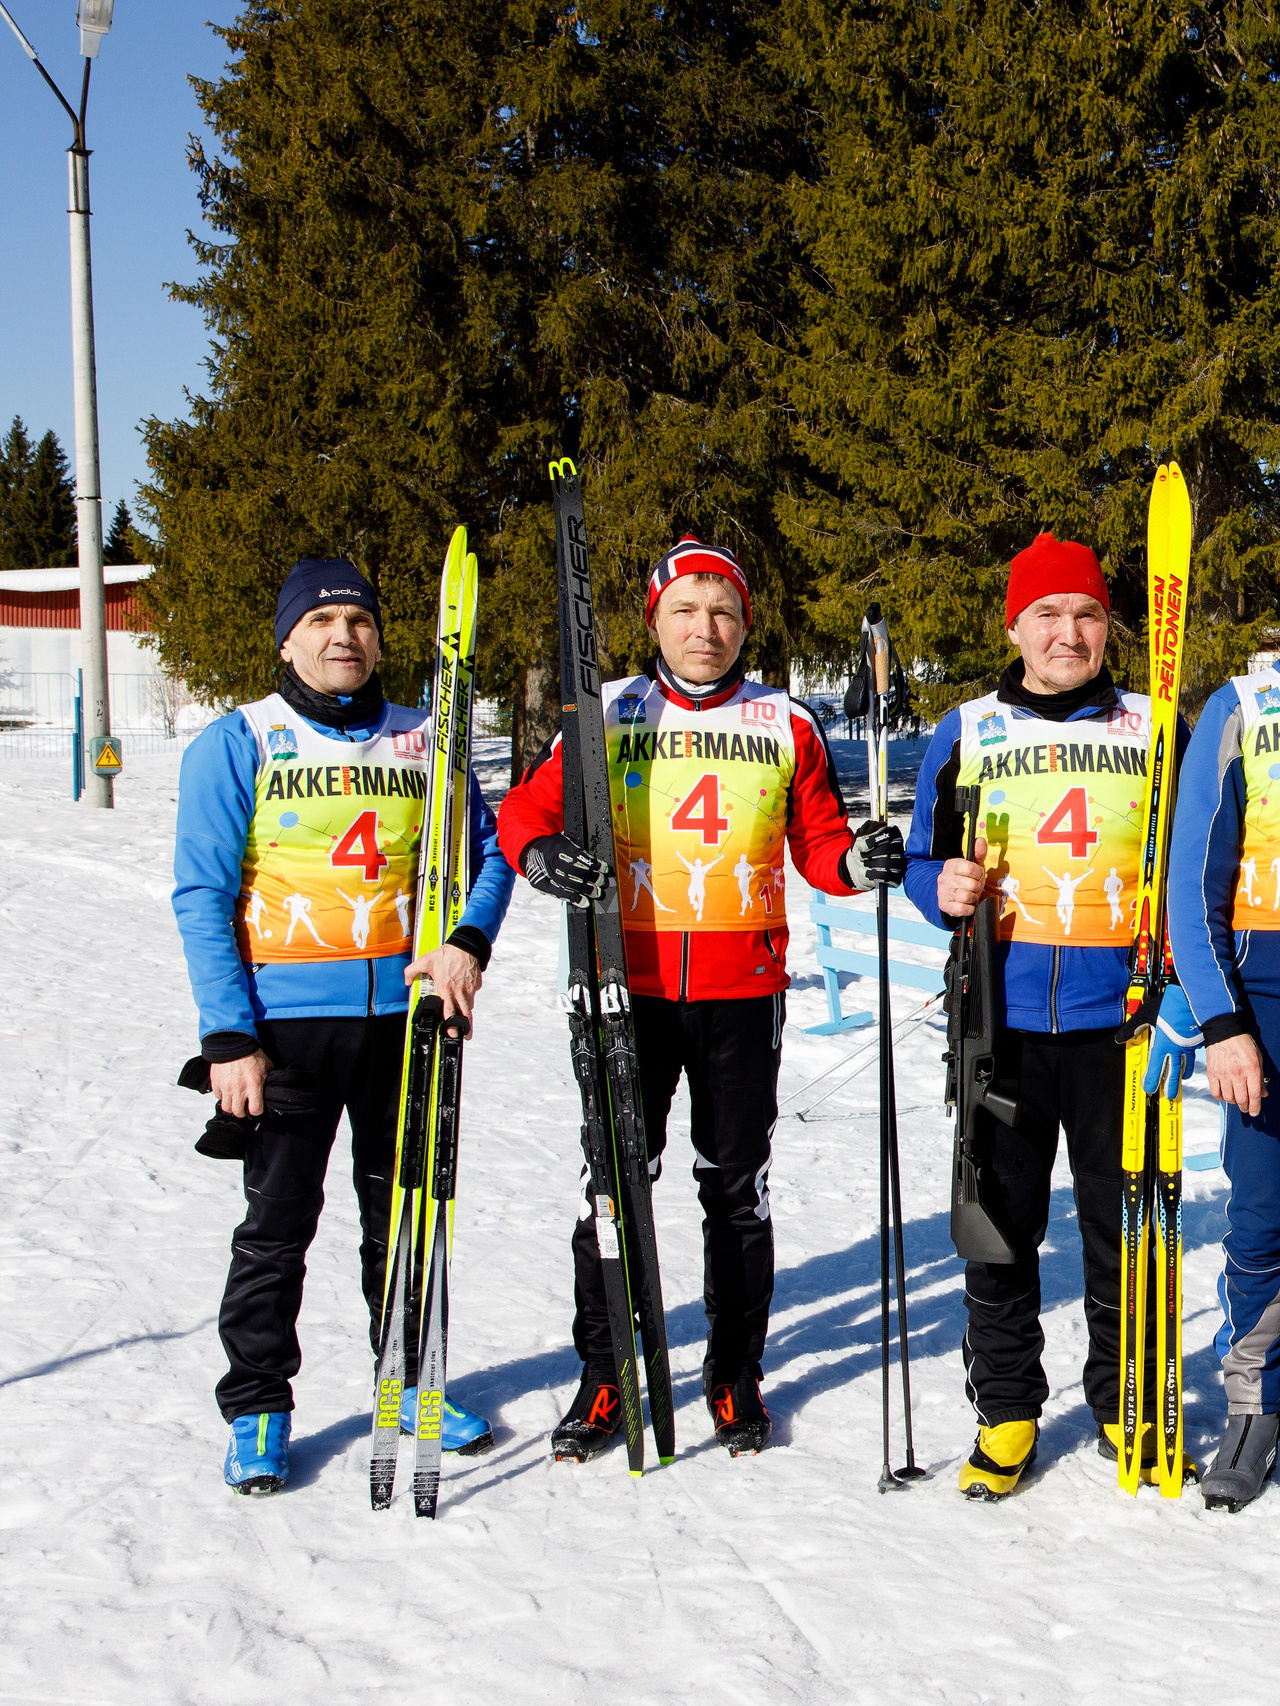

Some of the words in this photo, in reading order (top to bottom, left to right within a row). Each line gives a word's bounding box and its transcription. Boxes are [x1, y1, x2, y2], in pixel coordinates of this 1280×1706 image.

[331, 589, 361, 597] odlo
[567, 515, 599, 699] FISCHER
[1158, 573, 1183, 702] PELTONEN
[437, 655, 455, 754] FISCHER
[740, 697, 776, 720] ГТО
[454, 678, 470, 774] FISCHER
[684, 730, 693, 758] cement
[616, 730, 780, 767] AKKERMANN
[978, 743, 1148, 783] AKKERMANN
[1049, 744, 1058, 772] cement
[265, 765, 427, 800] AKKERMANN
[342, 766, 351, 796] cement
[1154, 761, 1162, 787] SKATING
[671, 773, 729, 845] 4
[1036, 786, 1098, 859] 4
[331, 810, 389, 882] 4
[759, 884, 772, 913] 1
[1126, 1358, 1135, 1389] Cosmic
[377, 1378, 402, 1428] RCS
[418, 1390, 442, 1440] RCS
[1125, 1395, 1136, 1433] Supra
[1165, 1395, 1177, 1434] Supra
